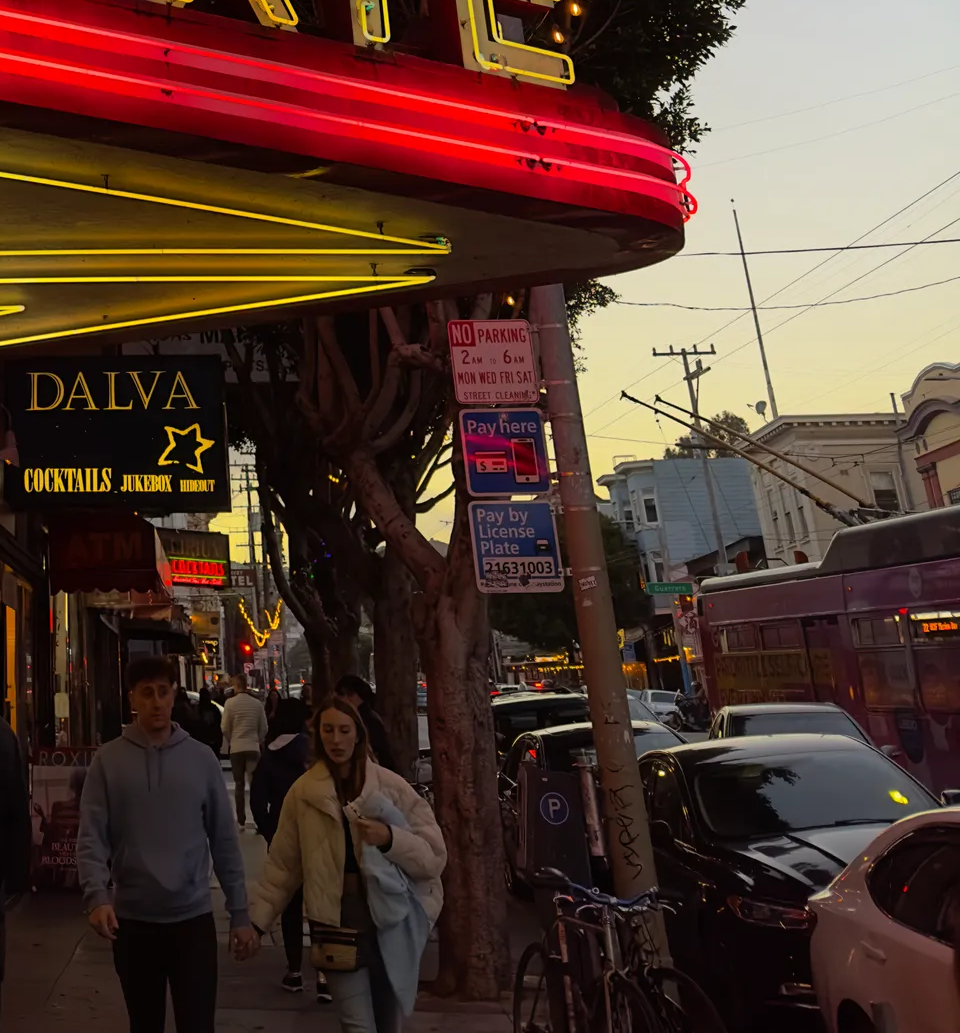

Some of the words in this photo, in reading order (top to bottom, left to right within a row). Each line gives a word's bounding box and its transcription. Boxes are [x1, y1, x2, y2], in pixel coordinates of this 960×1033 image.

[451, 323, 472, 344] NO
[477, 328, 527, 343] PARKING
[457, 371, 477, 385] MON
[479, 371, 497, 385] WED
[500, 370, 514, 384] FRI
[516, 370, 533, 384] SAT
[25, 370, 202, 411] DALVA
[463, 391, 491, 400] STREET
[467, 419, 497, 438] Pay
[499, 417, 538, 434] here
[23, 467, 113, 493] COCKTAILS
[120, 474, 173, 493] JUKEBOX
[179, 479, 216, 493] HIDEOUT
[476, 508, 504, 526] Pay
[508, 507, 528, 526] by
[478, 524, 536, 539] License
[68, 531, 143, 563] ATM
[480, 539, 520, 555] Plate
[485, 561, 554, 575] 21631003
